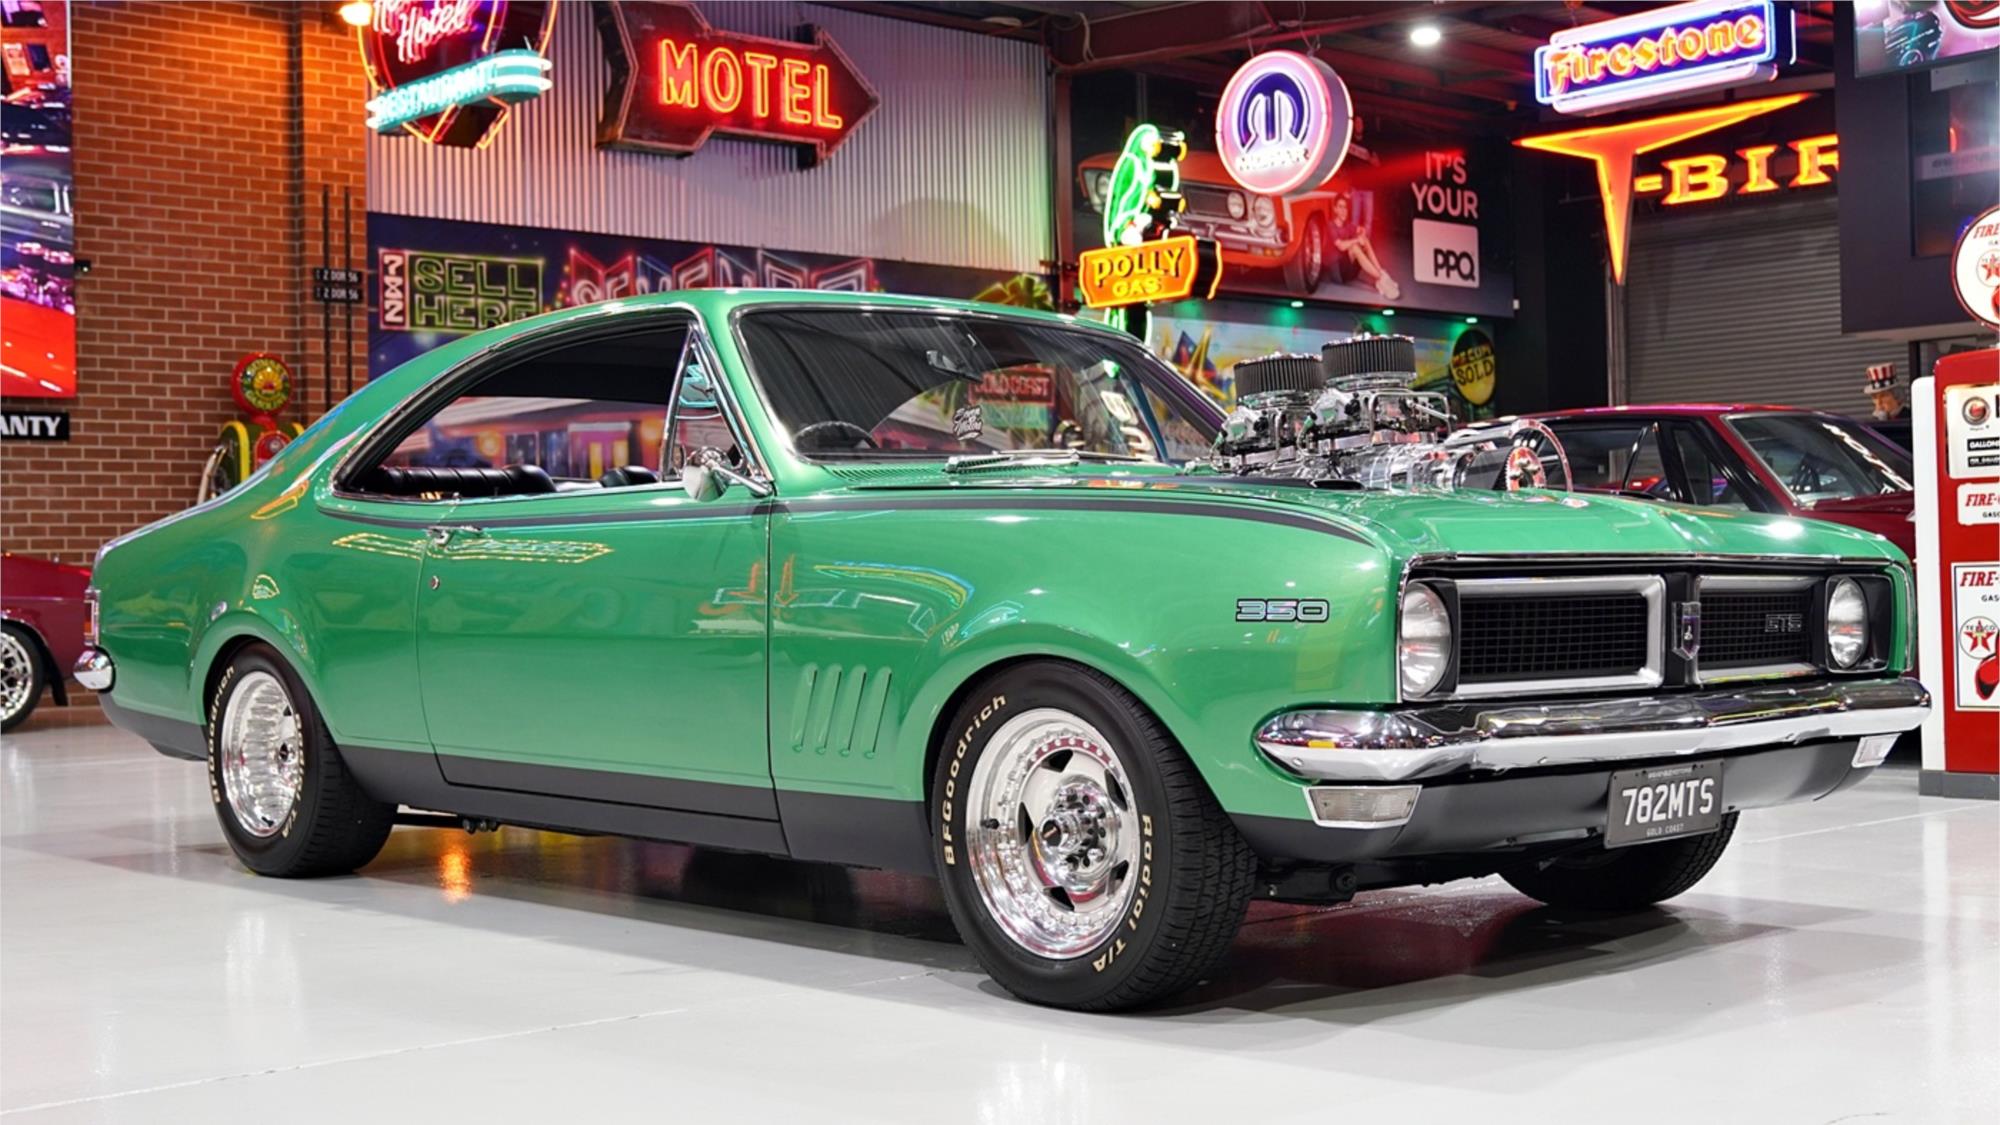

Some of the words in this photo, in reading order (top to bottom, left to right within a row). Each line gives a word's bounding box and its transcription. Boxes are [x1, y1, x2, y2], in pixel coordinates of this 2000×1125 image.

[396, 0, 469, 62] Hotel
[1549, 14, 1766, 94] Firestone
[660, 39, 843, 130] MOTEL
[1425, 151, 1467, 184] IT'S
[1411, 182, 1479, 220] YOUR
[413, 257, 538, 299] SELL
[1091, 247, 1185, 288] POLLY
[1433, 247, 1476, 282] PPQ
[1112, 276, 1163, 298] GAS
[1456, 360, 1494, 387] SOLD
[1235, 599, 1330, 623] 350
[1765, 613, 1803, 633] GTS
[942, 695, 1007, 866] BFGoodrich
[1622, 778, 1715, 826] 782MTS
[1128, 814, 1153, 931] Radial
[1092, 938, 1127, 973] T/A
